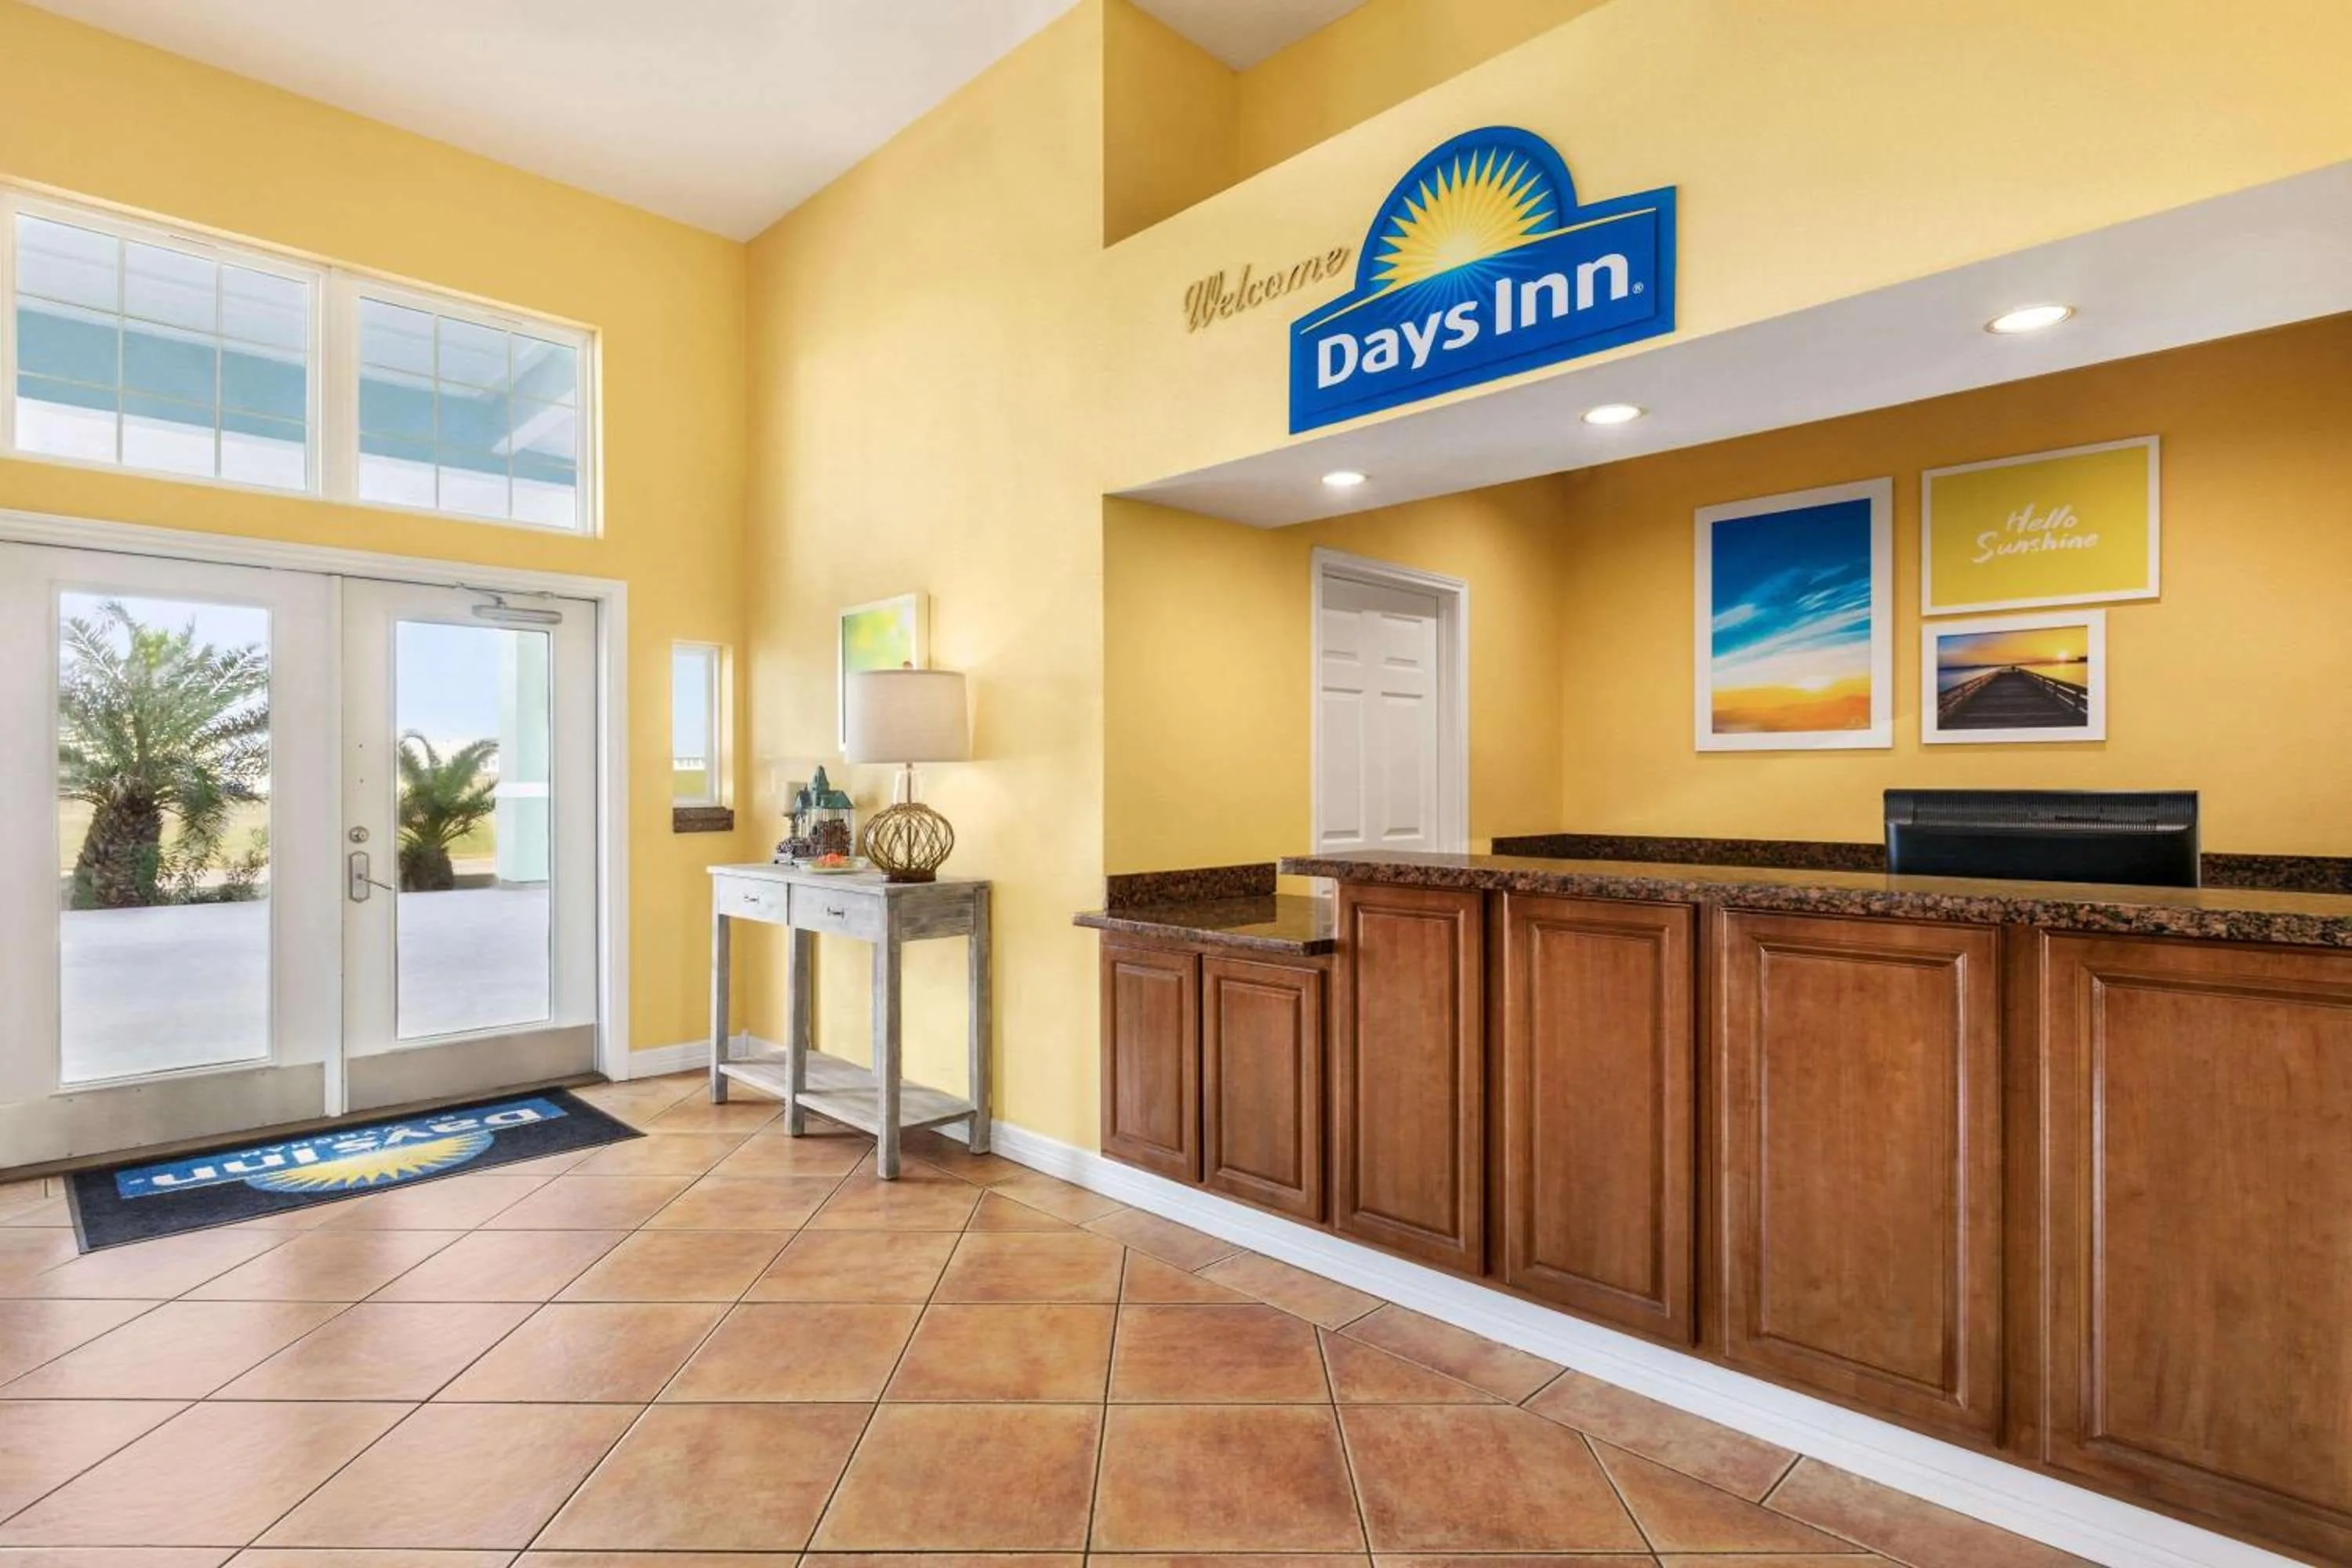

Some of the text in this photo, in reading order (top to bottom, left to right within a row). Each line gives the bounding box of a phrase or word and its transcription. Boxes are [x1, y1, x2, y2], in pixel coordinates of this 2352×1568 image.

[1184, 247, 1351, 334] Welcome
[1318, 253, 1628, 389] Days Inn
[1971, 529, 2100, 564] Sunshine
[2005, 502, 2078, 533] Hello
[151, 1108, 542, 1186] Days Inn
